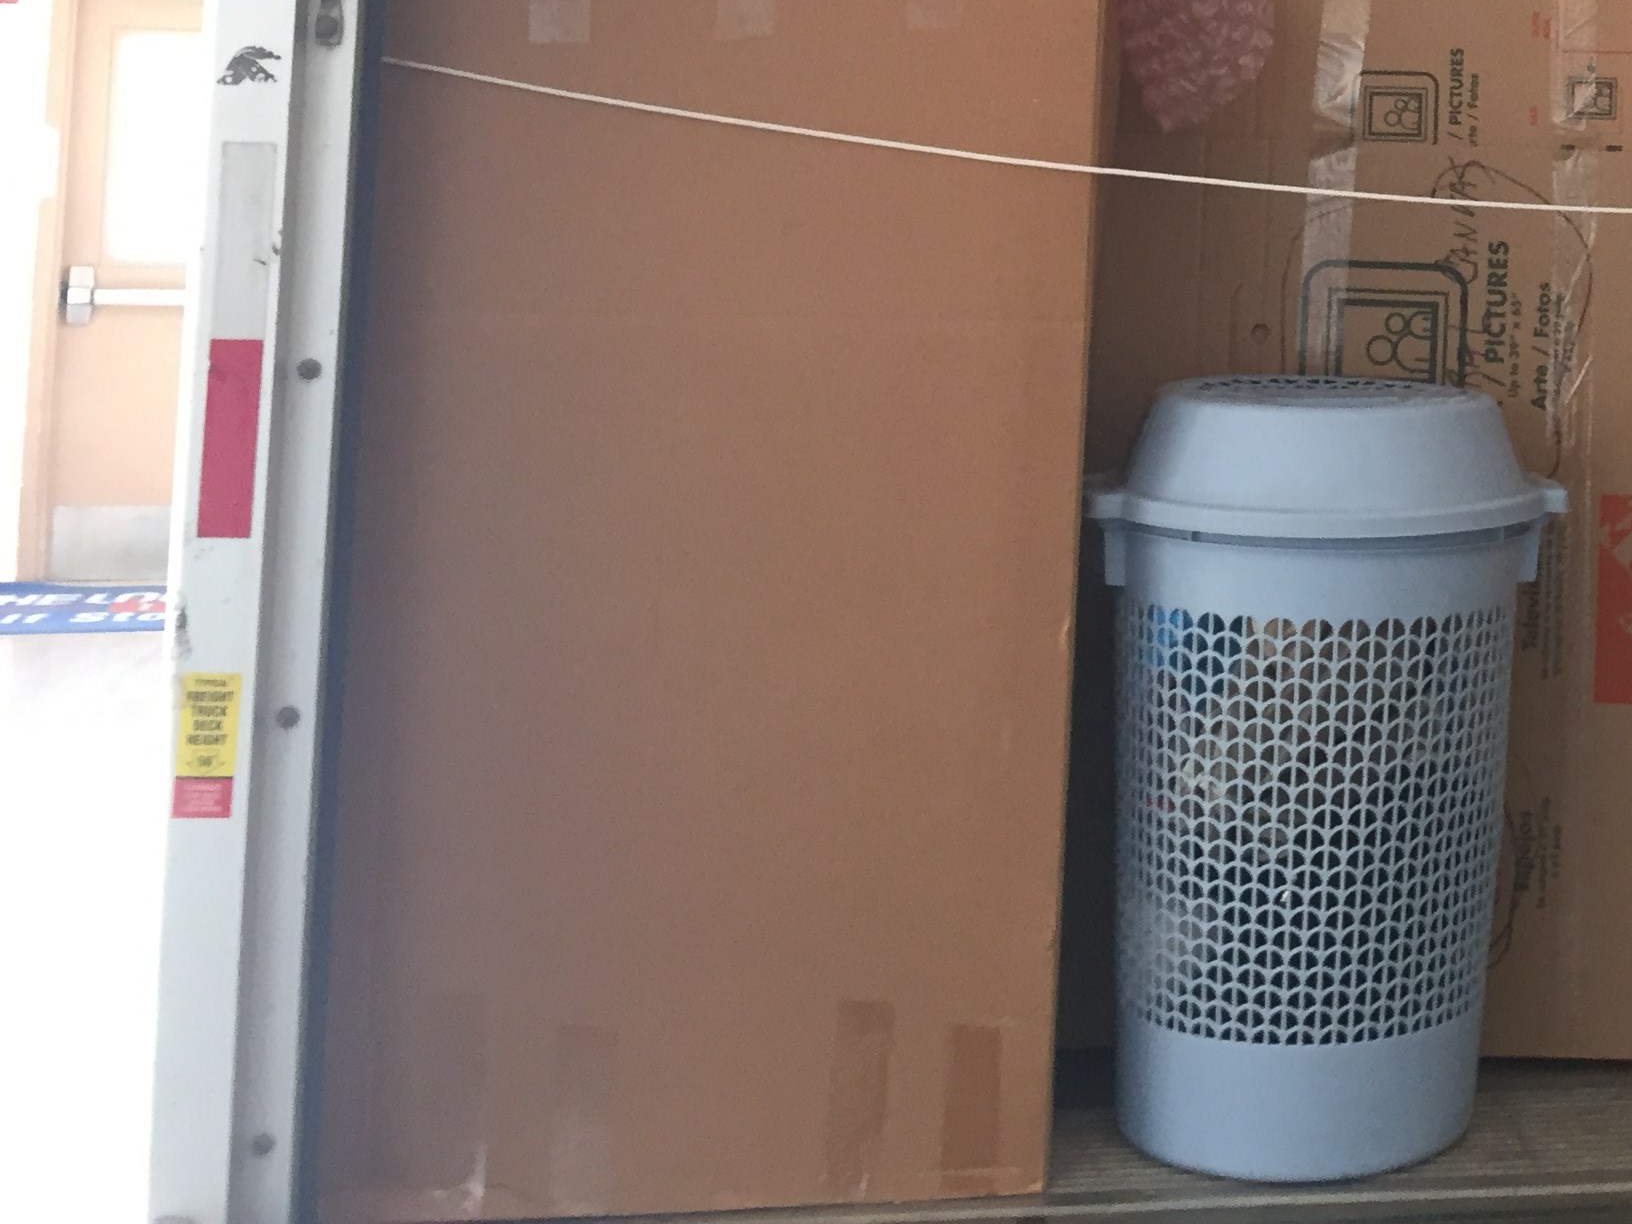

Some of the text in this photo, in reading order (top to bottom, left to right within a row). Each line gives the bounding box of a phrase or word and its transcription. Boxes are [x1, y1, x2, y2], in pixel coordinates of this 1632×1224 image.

[1448, 48, 1465, 126] PICTURES
[1484, 241, 1510, 364] PICTURES
[1533, 282, 1552, 338] Fotos
[1507, 380, 1521, 398] Up
[1509, 363, 1519, 376] to
[1531, 364, 1549, 411] Arte
